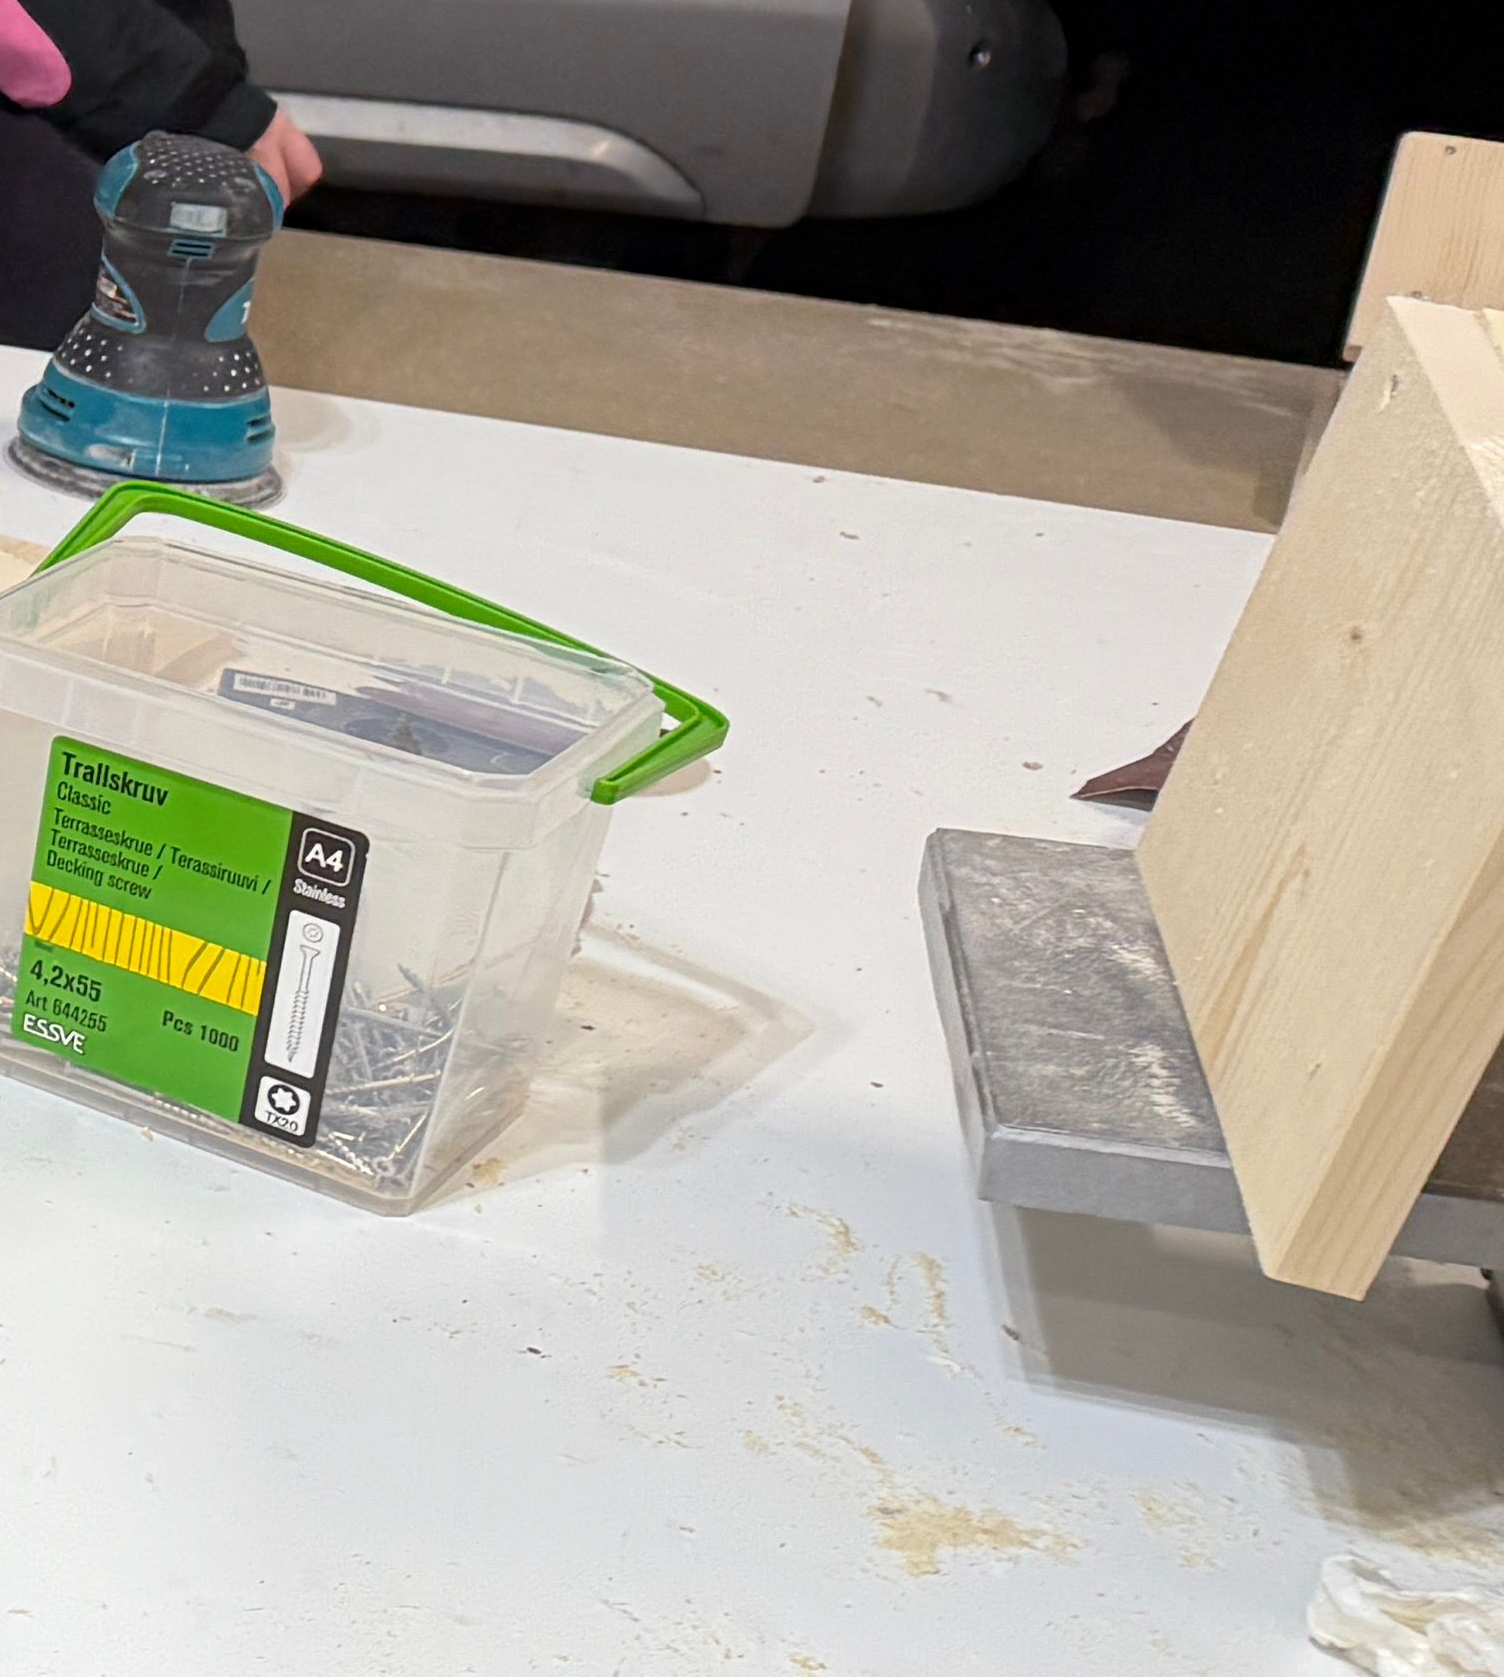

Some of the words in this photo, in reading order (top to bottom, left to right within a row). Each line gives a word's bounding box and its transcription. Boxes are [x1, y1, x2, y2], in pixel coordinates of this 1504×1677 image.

[57, 780, 112, 815] Classic
[62, 751, 169, 806] Trallskruv
[50, 828, 150, 878] Terrasseskrue
[53, 807, 153, 856] Terrasseskrue
[169, 845, 259, 892] Terassiruuvi
[304, 842, 344, 873] A4
[46, 849, 104, 887] Decking
[108, 874, 153, 899] screw
[292, 877, 346, 909] Stainless
[30, 958, 103, 1002] 4,2x55
[25, 990, 48, 1011] Art
[52, 998, 108, 1033] 644255
[161, 1010, 194, 1036] Pcs
[200, 1023, 240, 1052] 1000
[22, 1013, 86, 1054] ESSVE
[264, 1109, 299, 1132] TX20
